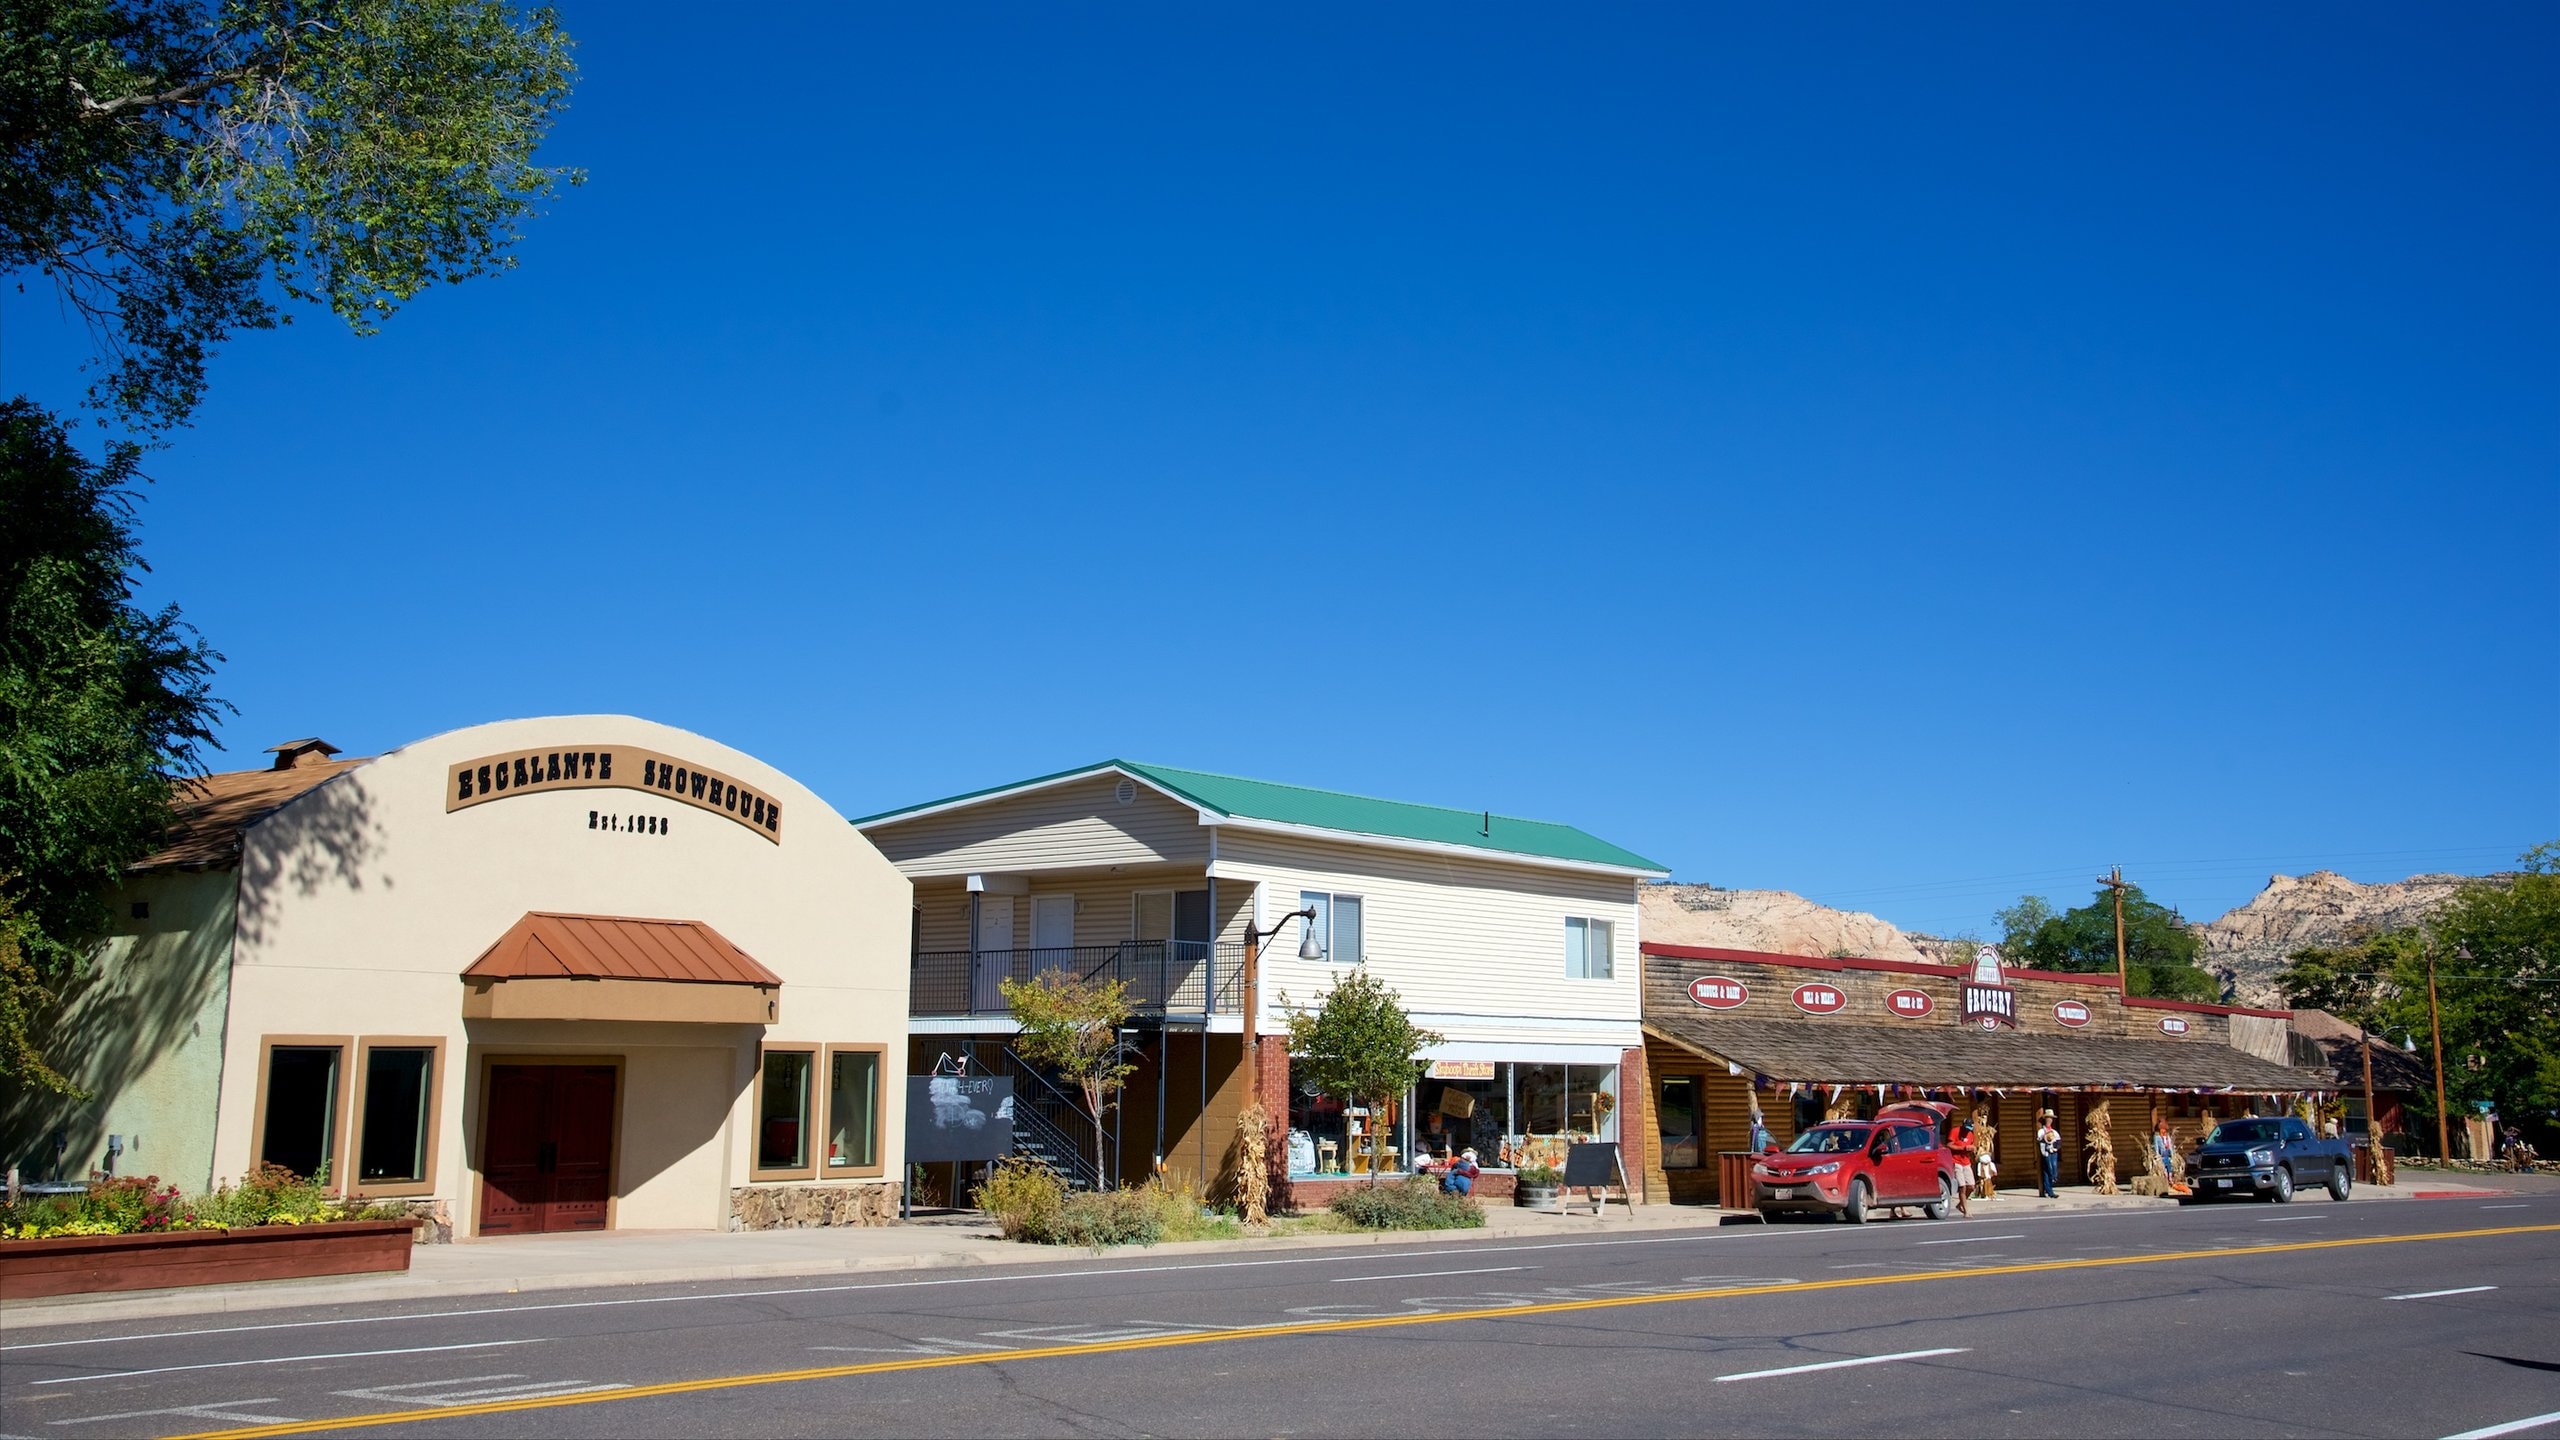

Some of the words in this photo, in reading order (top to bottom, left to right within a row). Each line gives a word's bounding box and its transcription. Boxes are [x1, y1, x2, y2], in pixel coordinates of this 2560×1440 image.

[459, 752, 611, 800] ESCALANTE
[644, 759, 779, 832] SHOWHOUSE
[1967, 987, 2012, 1017] GROCERY
